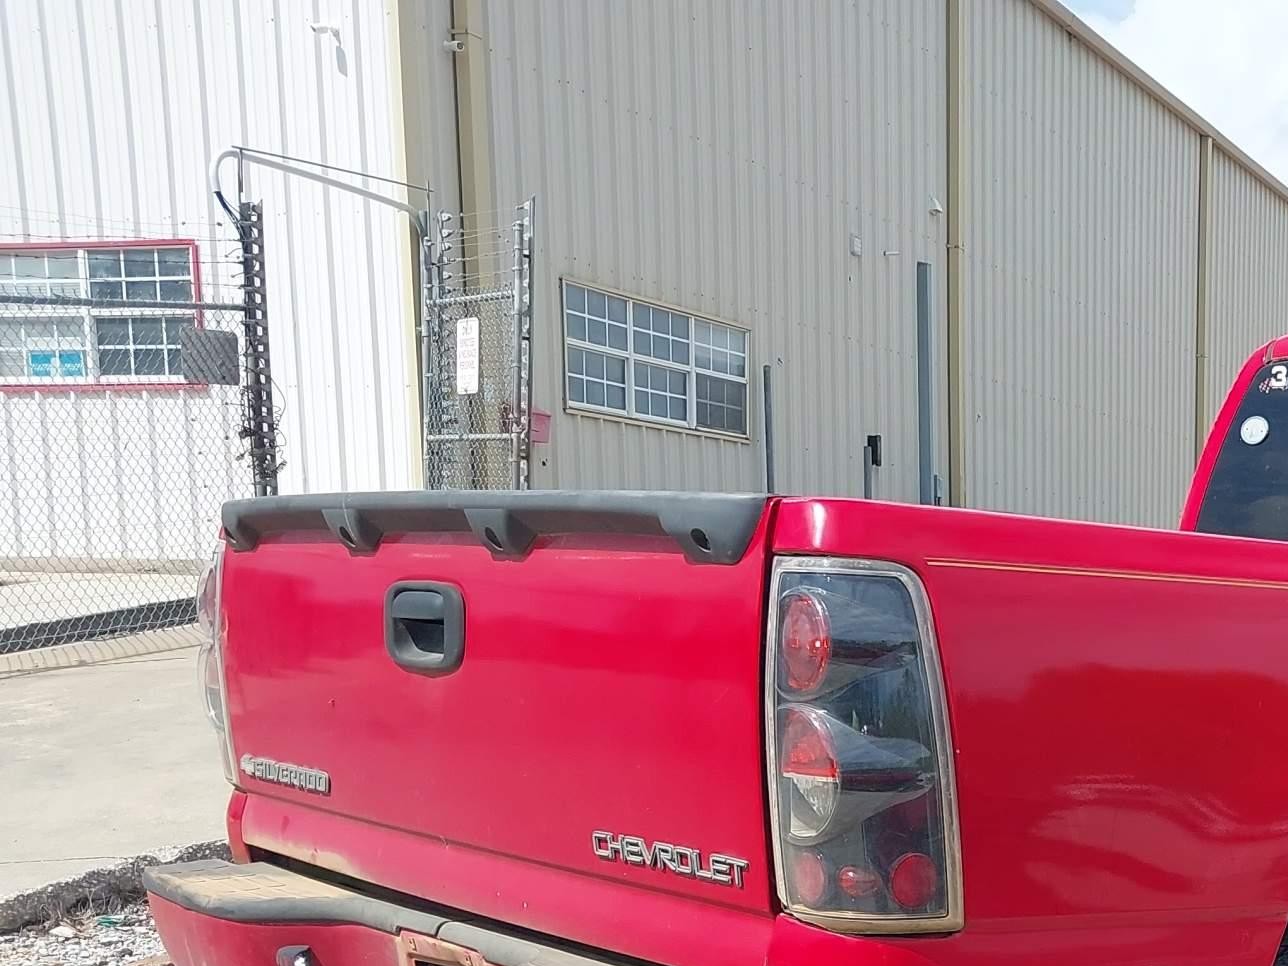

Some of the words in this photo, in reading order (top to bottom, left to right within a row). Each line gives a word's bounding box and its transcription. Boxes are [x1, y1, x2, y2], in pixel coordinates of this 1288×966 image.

[1271, 365, 1287, 387] 3
[254, 760, 330, 794] SILVERADO
[592, 830, 749, 888] CHEVROLET
